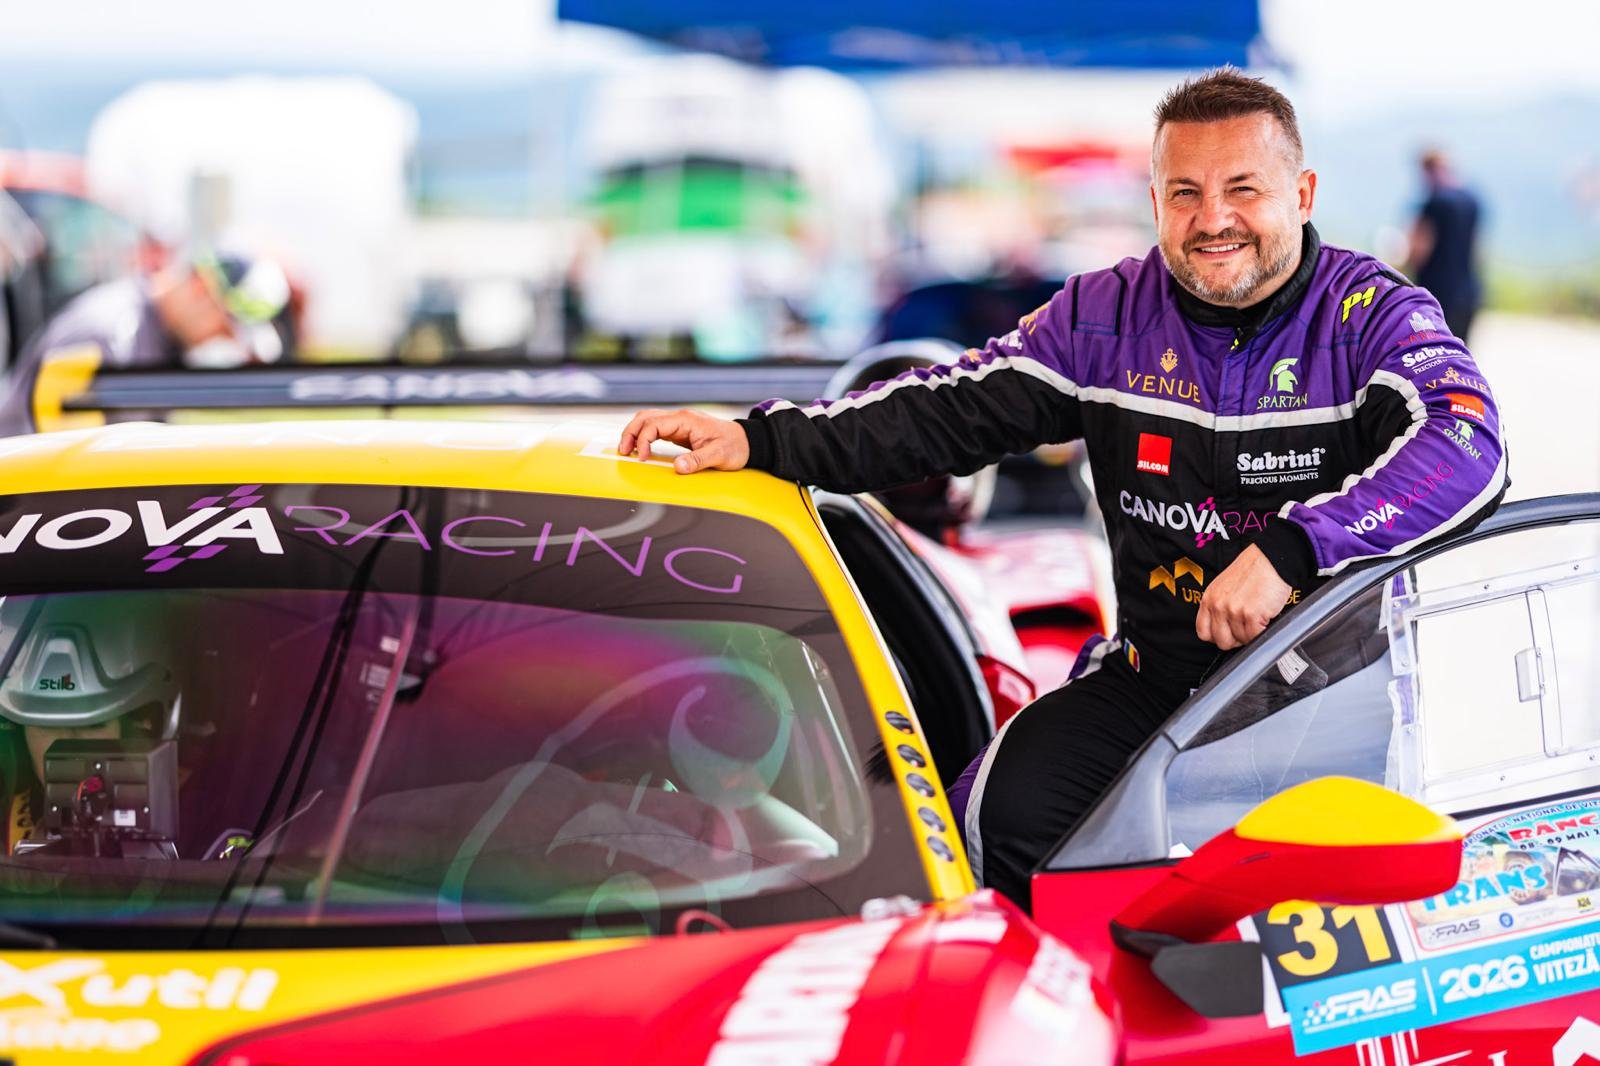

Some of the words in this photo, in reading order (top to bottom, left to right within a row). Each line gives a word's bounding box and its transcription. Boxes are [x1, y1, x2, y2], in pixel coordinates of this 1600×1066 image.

[1342, 286, 1377, 323] P1
[1127, 370, 1200, 403] VENUE
[1257, 393, 1308, 409] SPARTAN
[1444, 428, 1482, 460] SPARTAN
[1137, 460, 1169, 474] SILCOM
[1240, 475, 1278, 485] PRECIOUS
[1279, 472, 1319, 483] MOMENTS
[1392, 461, 1454, 510] RACING
[1119, 490, 1230, 541] CANOVA
[283, 505, 748, 593] RACING
[39, 673, 76, 691] Stilo
[1267, 899, 1392, 976] 31
[1435, 919, 1480, 938] FRAS
[1325, 978, 1417, 1022] FRAS
[1438, 954, 1530, 1004] 2026
